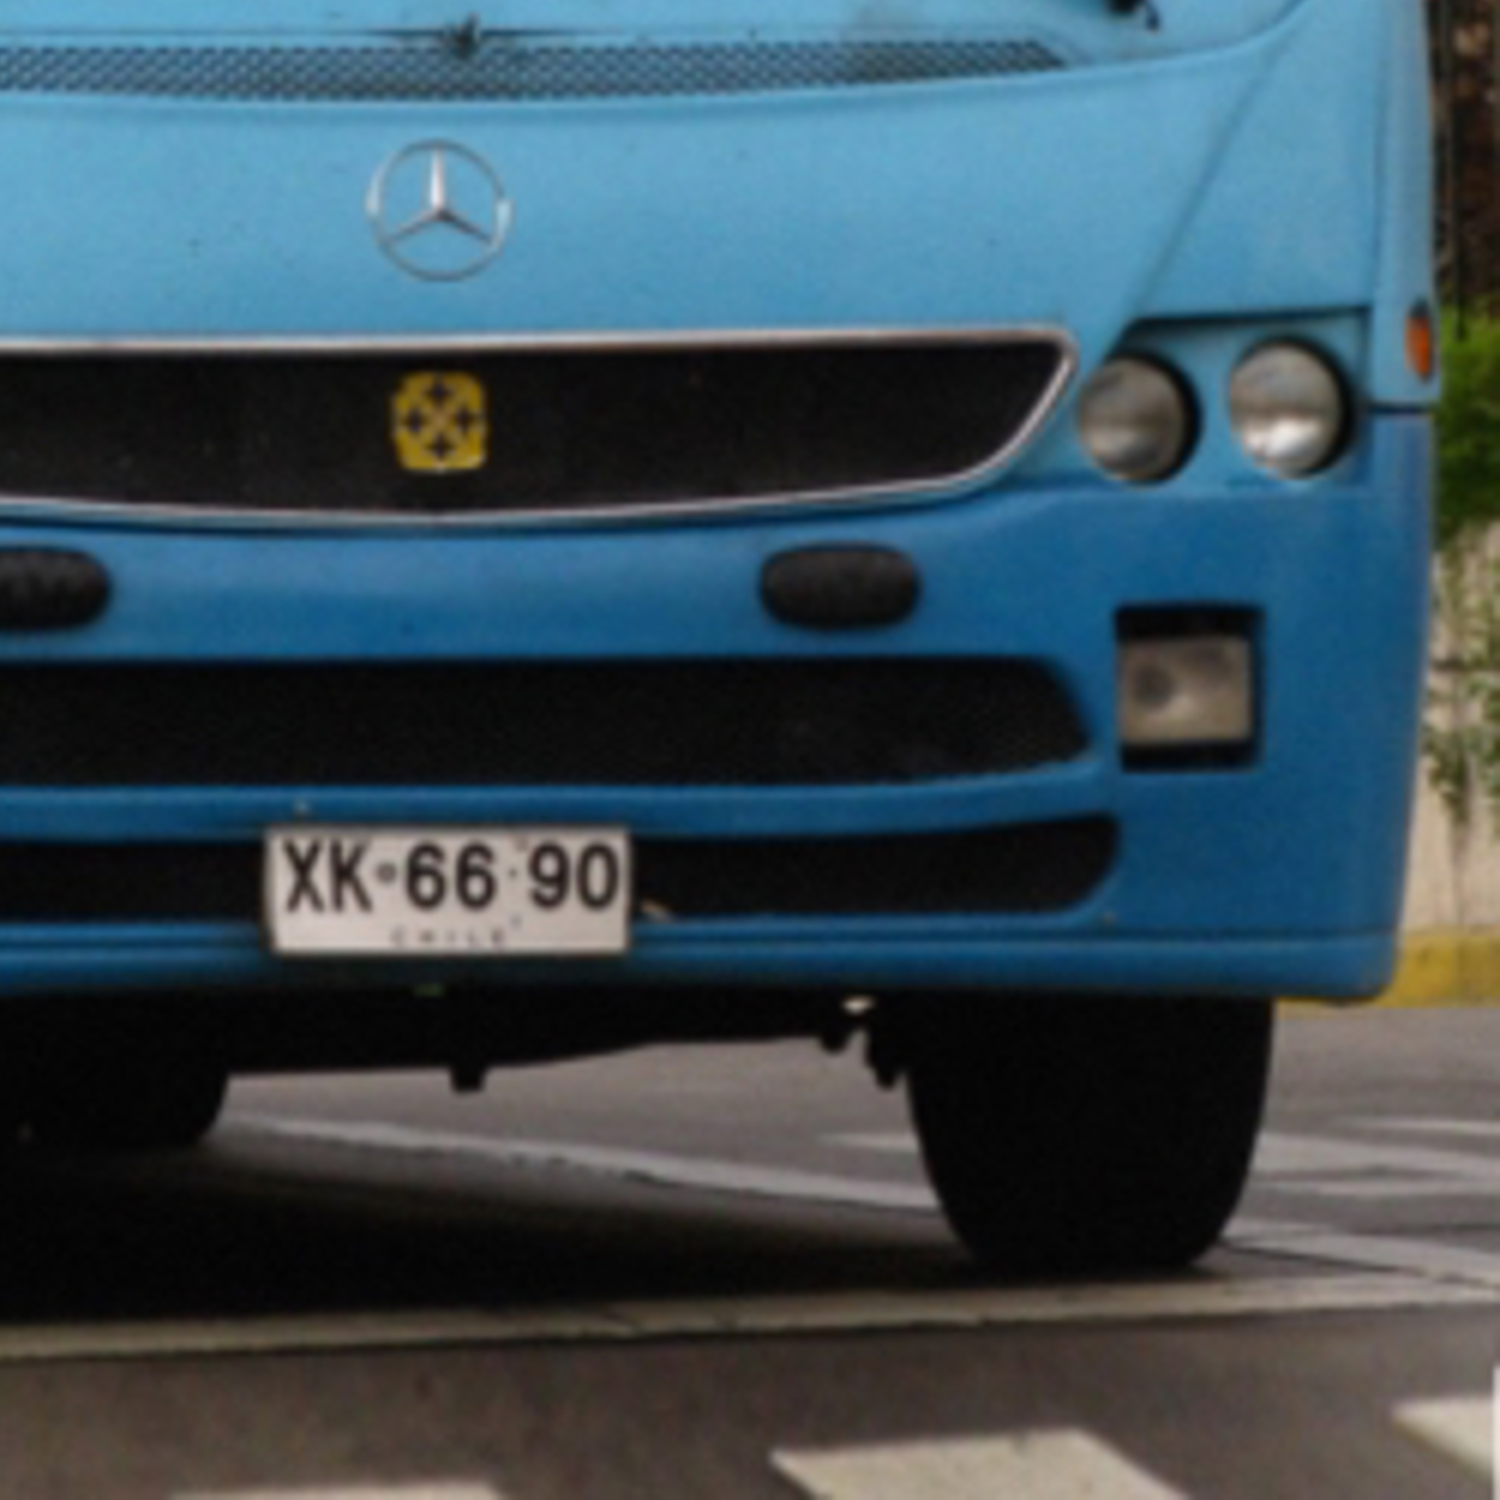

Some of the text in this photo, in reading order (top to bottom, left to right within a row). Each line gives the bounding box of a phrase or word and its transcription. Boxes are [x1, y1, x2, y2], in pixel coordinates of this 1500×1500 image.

[283, 840, 620, 913] XK 66 90
